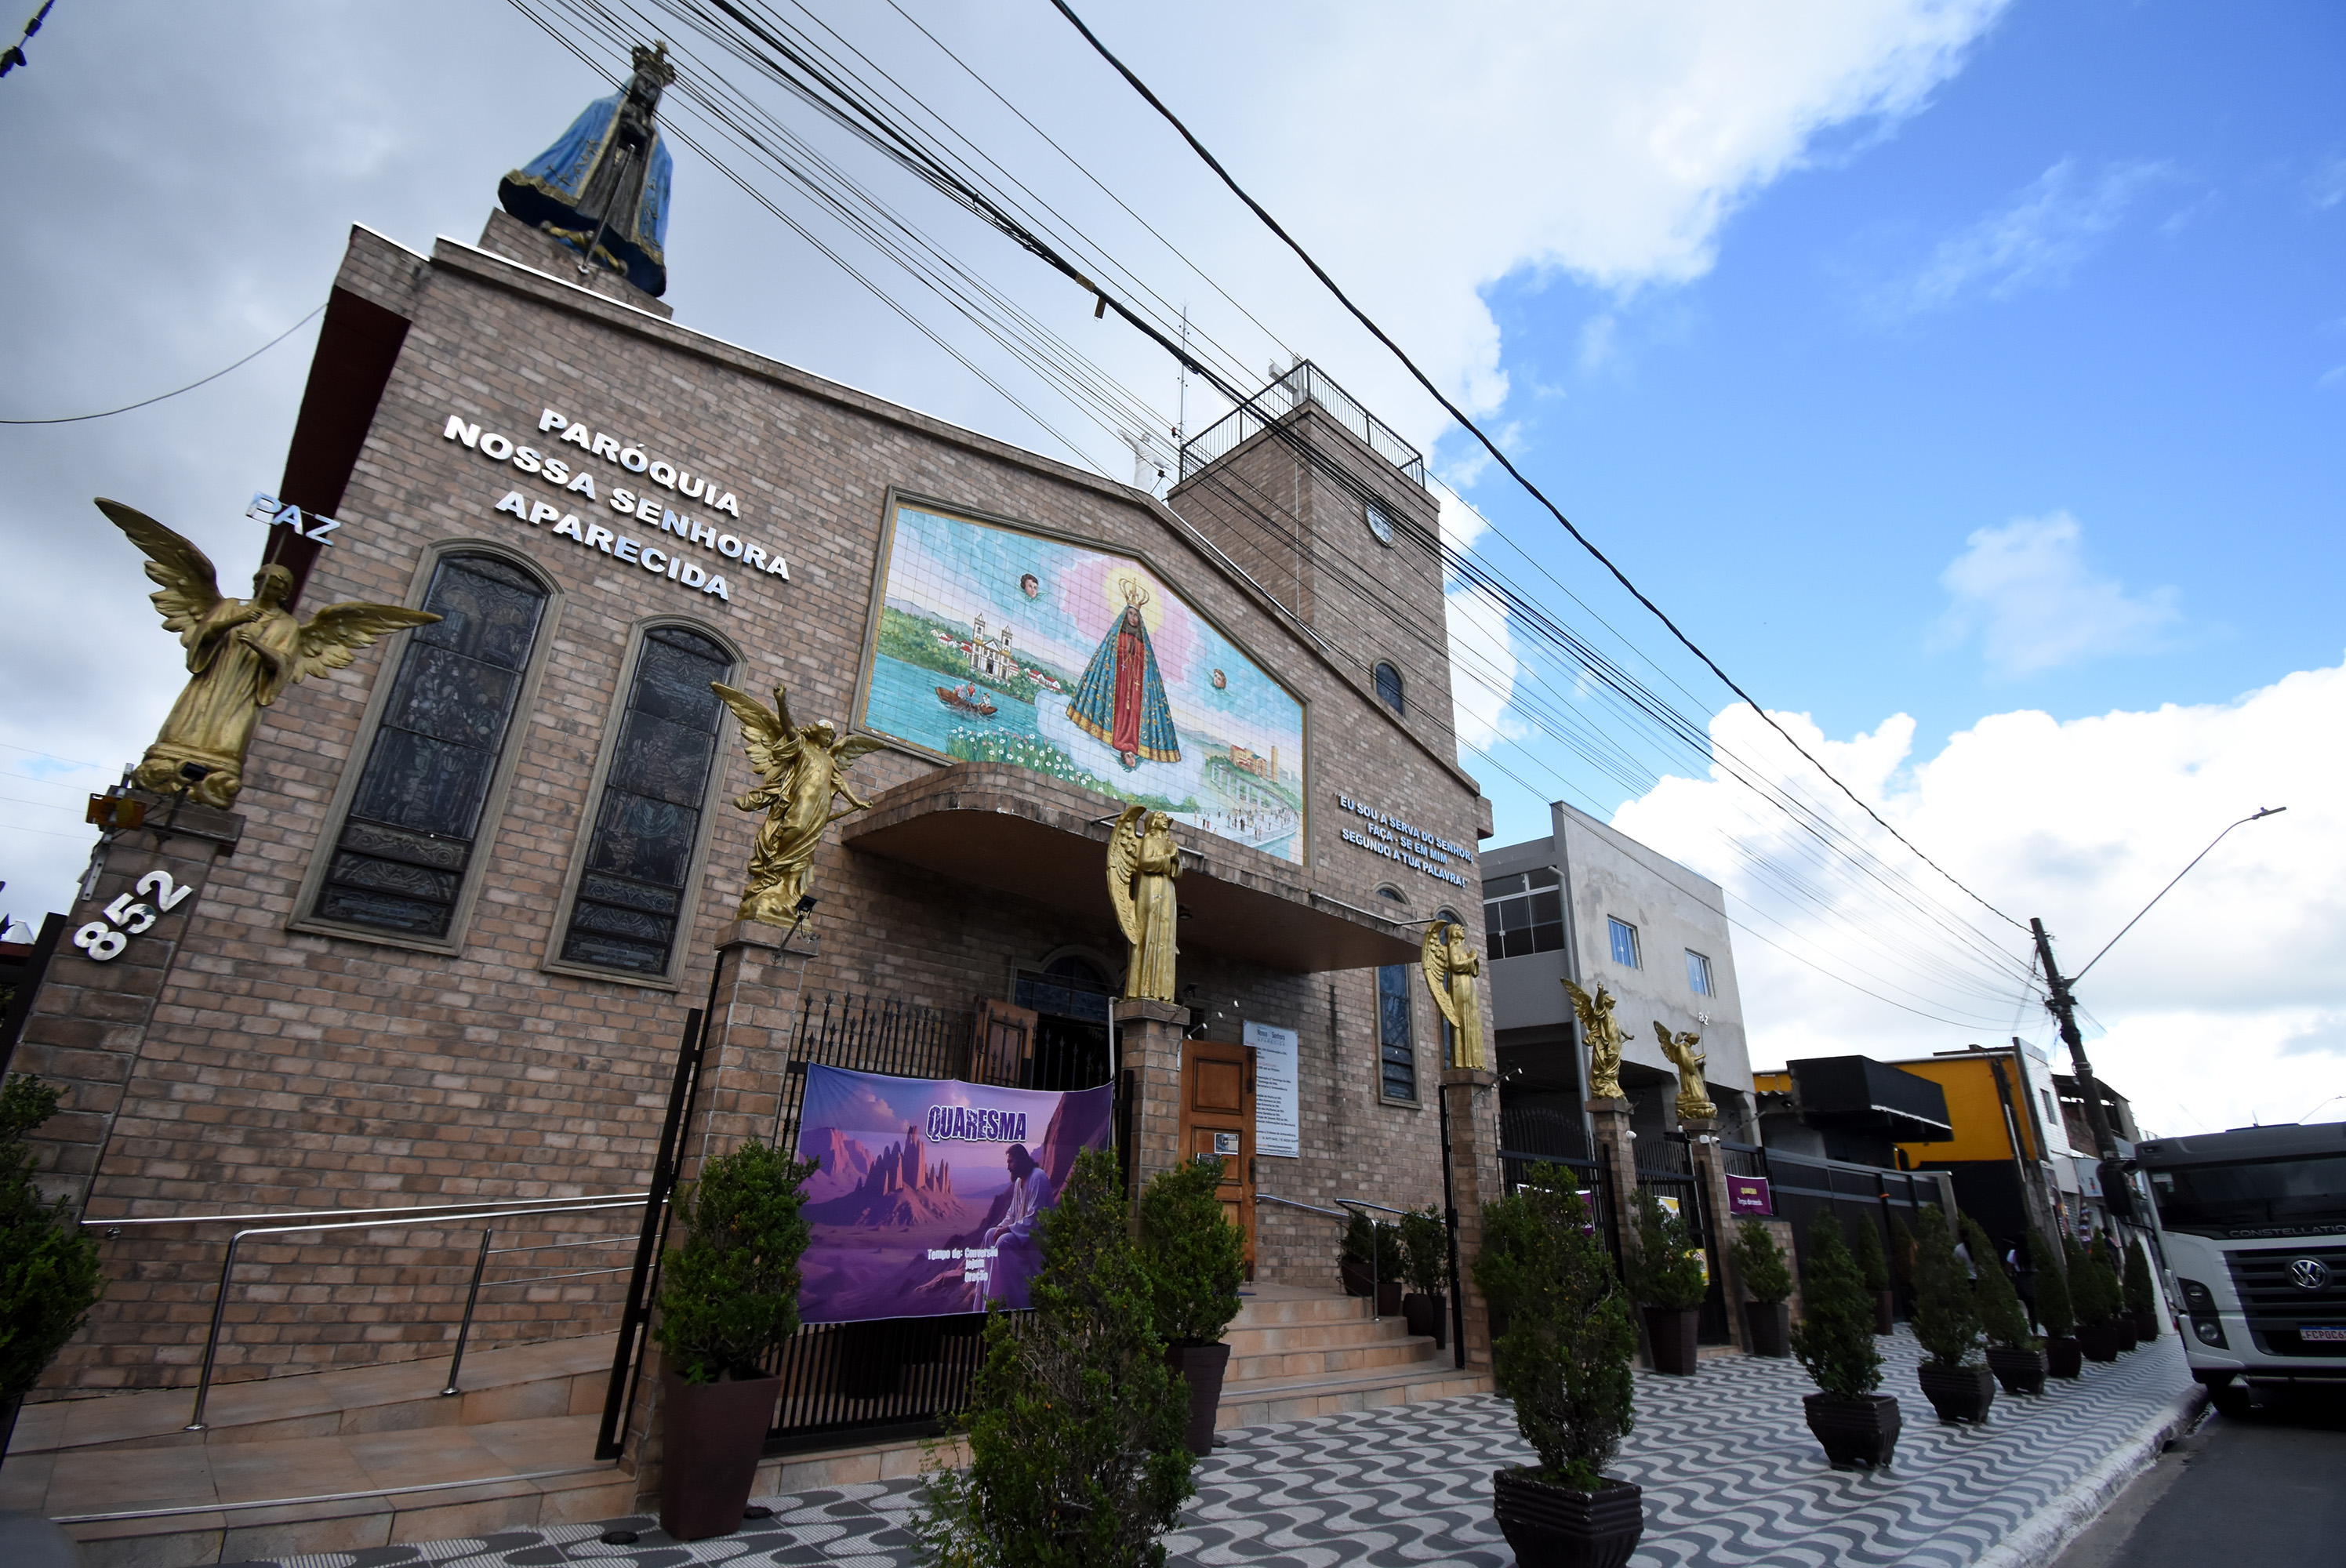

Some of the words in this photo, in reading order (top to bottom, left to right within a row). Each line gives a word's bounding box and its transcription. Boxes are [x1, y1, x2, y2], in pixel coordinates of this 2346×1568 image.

[538, 408, 739, 517] PARÓQUIA
[245, 490, 341, 546] PAZ
[443, 415, 596, 500] NOSSA
[609, 488, 790, 581] SENHORA
[495, 490, 729, 601] APARECIDA
[1356, 802, 1378, 820] SOU
[1380, 812, 1388, 825] A
[1389, 817, 1420, 839] SERVA
[1422, 829, 1434, 845] DO
[1367, 822, 1393, 842] FAÇA
[1400, 837, 1413, 850] SE
[1414, 842, 1428, 857] EM
[1429, 848, 1448, 865] MIM
[1342, 828, 1391, 858] SEGUNDO
[1393, 849, 1400, 862] A
[1401, 853, 1421, 870] TUA
[73, 869, 194, 961] 852
[926, 1105, 1028, 1142] QUARESMA
[927, 1248, 951, 1261] Tempo
[951, 1247, 963, 1259] de:
[964, 1245, 999, 1258] Conversão
[964, 1258, 985, 1270] Jejum
[964, 1269, 988, 1283] Oração
